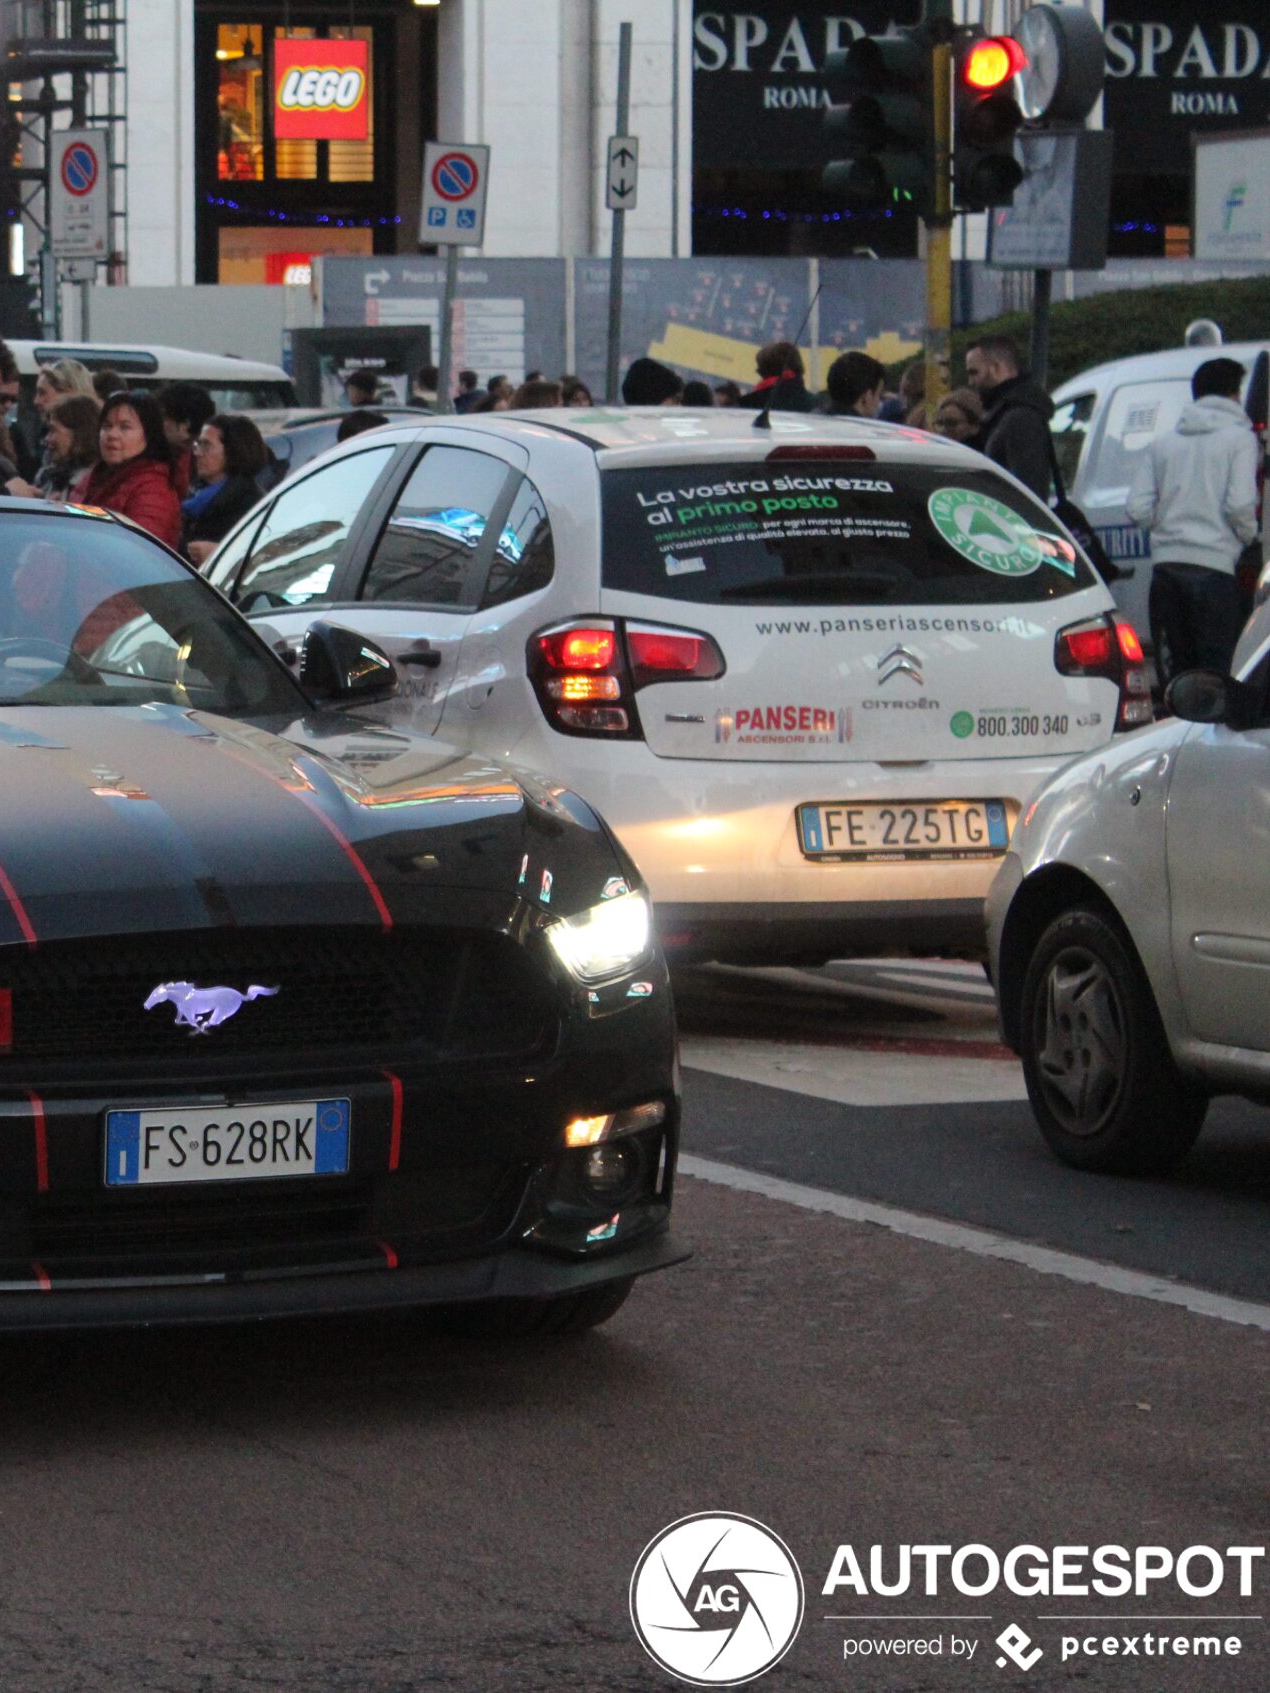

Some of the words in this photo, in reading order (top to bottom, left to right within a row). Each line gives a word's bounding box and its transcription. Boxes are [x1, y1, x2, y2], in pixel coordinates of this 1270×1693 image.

[694, 12, 902, 72] SPAD
[1104, 22, 1270, 78] SPAD
[281, 69, 361, 107] LEGO
[763, 86, 833, 109] ROMA
[1171, 91, 1239, 114] ROMA
[636, 490, 676, 507] La
[679, 480, 769, 500] vostra
[772, 475, 894, 493] sicurezza
[647, 507, 673, 525] al
[676, 499, 758, 524] primo
[762, 494, 839, 515] posto
[655, 524, 712, 541] IMPIANTO
[763, 520, 781, 529] per
[783, 518, 806, 529] ogni
[808, 518, 842, 526] marca
[843, 517, 854, 526] di
[659, 534, 734, 553] un'assistenza
[735, 532, 745, 541] di
[746, 529, 785, 541] qualità
[831, 527, 841, 536] al
[842, 528, 874, 539] giusto
[875, 530, 911, 539] prezzo
[951, 531, 1035, 571] SICURO
[735, 706, 835, 731] PANSERI
[977, 716, 1040, 737] 800.300
[1042, 714, 1069, 735] 340
[737, 734, 805, 743] ASCENSORI
